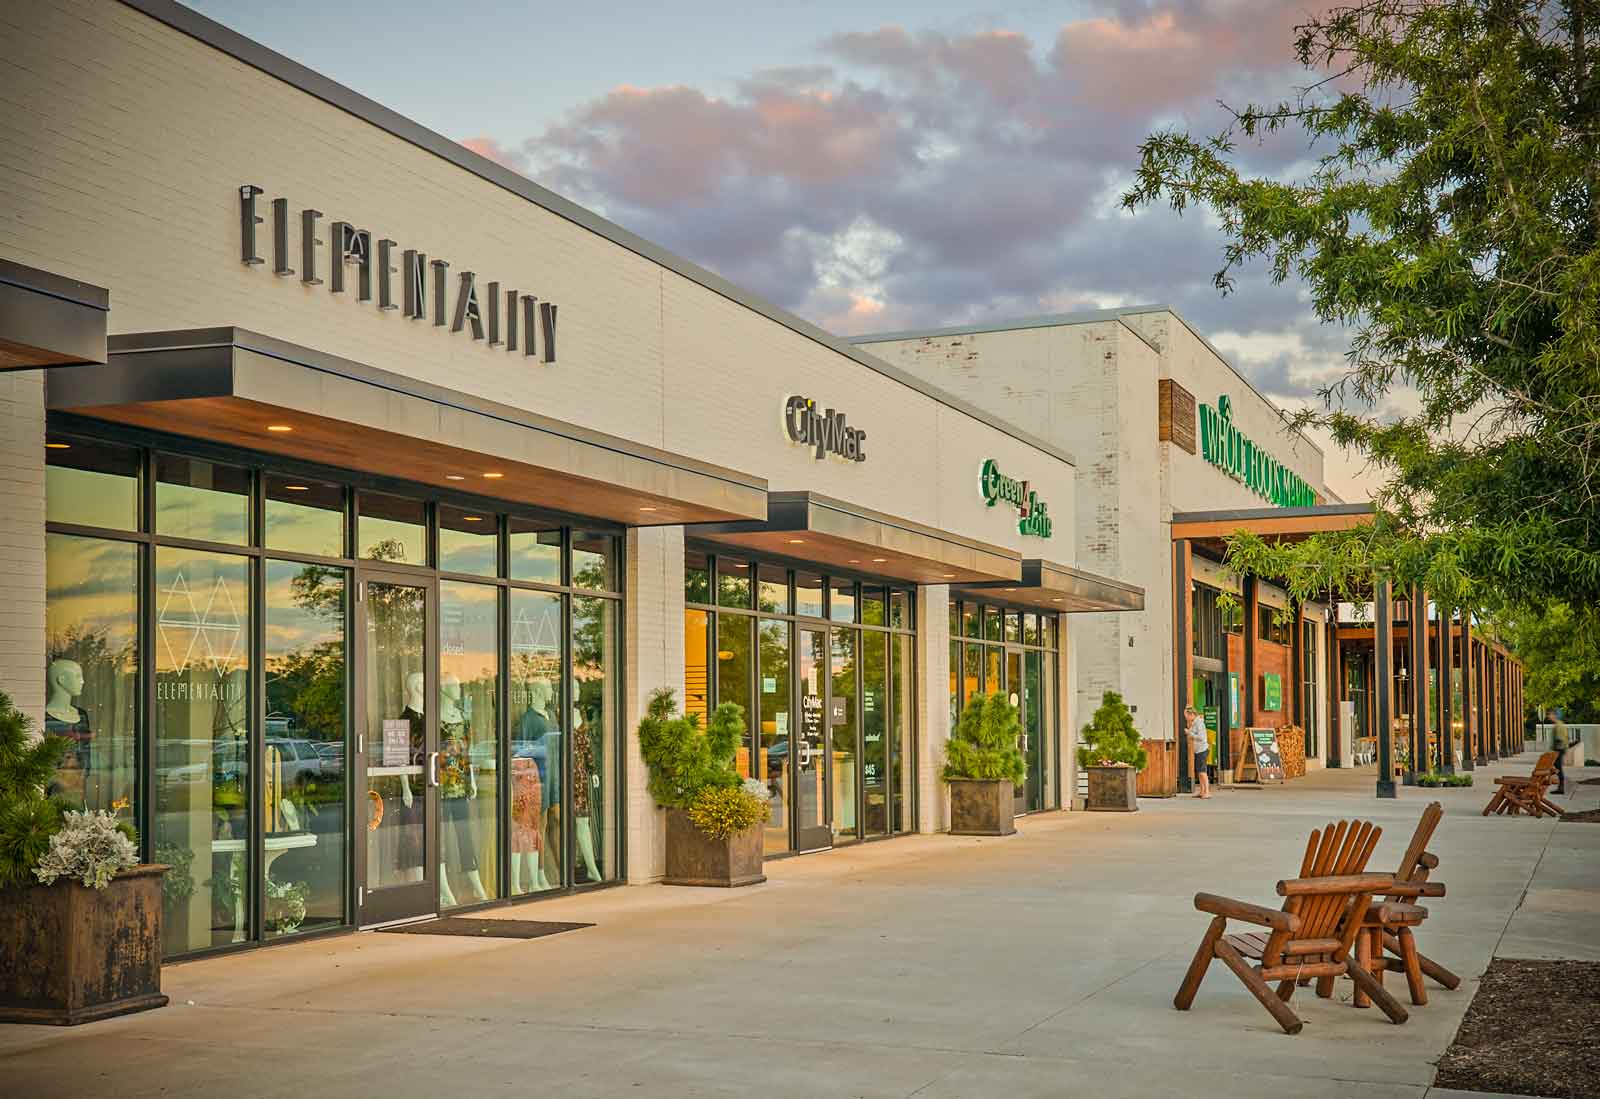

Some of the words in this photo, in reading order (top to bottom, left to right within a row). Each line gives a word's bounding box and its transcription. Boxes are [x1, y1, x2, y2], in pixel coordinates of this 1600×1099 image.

[240, 184, 558, 363] ELEMENTALITY
[785, 395, 866, 462] CityMac
[1199, 395, 1248, 483] WHOLE
[1245, 439, 1281, 507] FOODS
[979, 458, 1024, 507] Green
[157, 682, 242, 701] ELEMENTALITY
